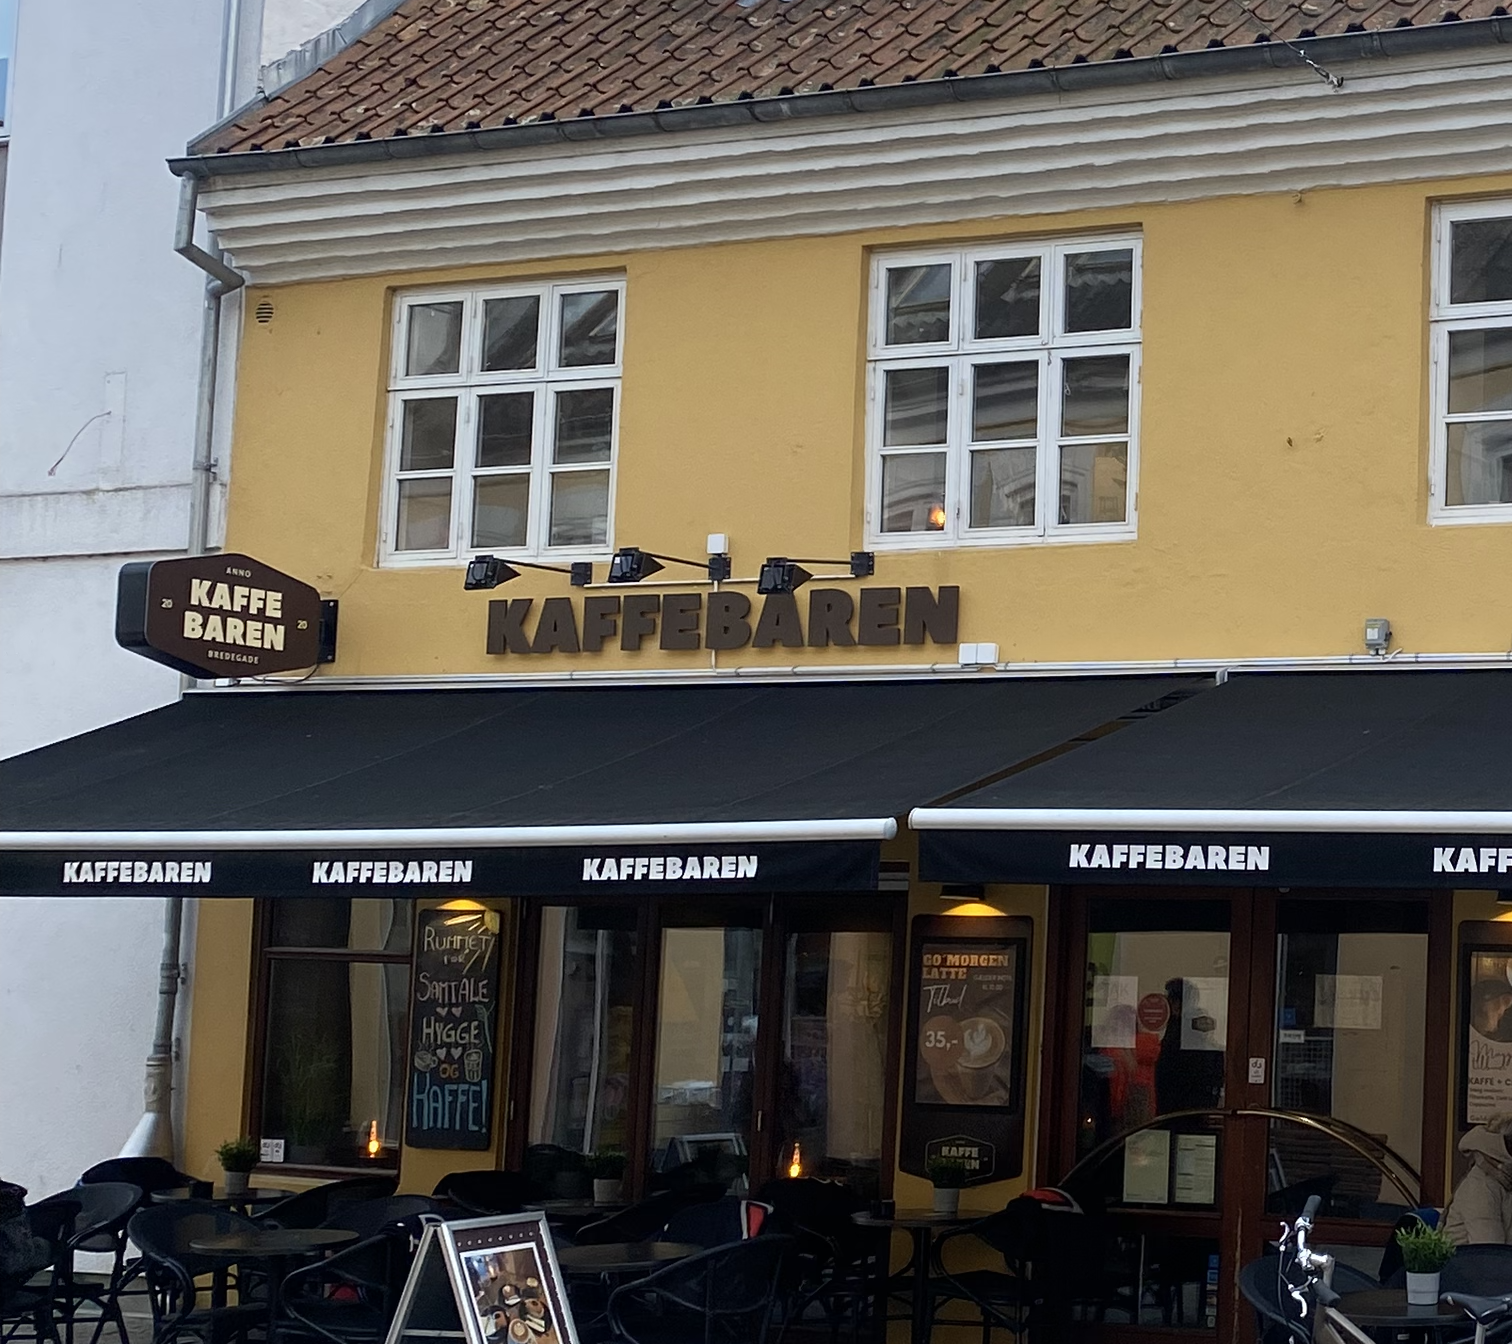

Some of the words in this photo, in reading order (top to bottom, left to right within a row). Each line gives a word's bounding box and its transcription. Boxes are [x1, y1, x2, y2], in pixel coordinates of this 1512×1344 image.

[226, 567, 251, 578] ANNO
[161, 598, 173, 609] 20
[190, 578, 283, 619] KAFFE
[183, 610, 286, 652] BAREN
[297, 619, 308, 630] 20
[486, 585, 960, 655] KAFFEBAREN
[208, 649, 259, 665] BREDEGADE
[582, 856, 758, 881] KAFFEBAREN
[1069, 843, 1270, 871] KAFFEBAREN
[63, 861, 212, 884] KAFFEBAREN
[312, 860, 473, 884] KAFFEBAREN
[922, 967, 967, 980] LATTE
